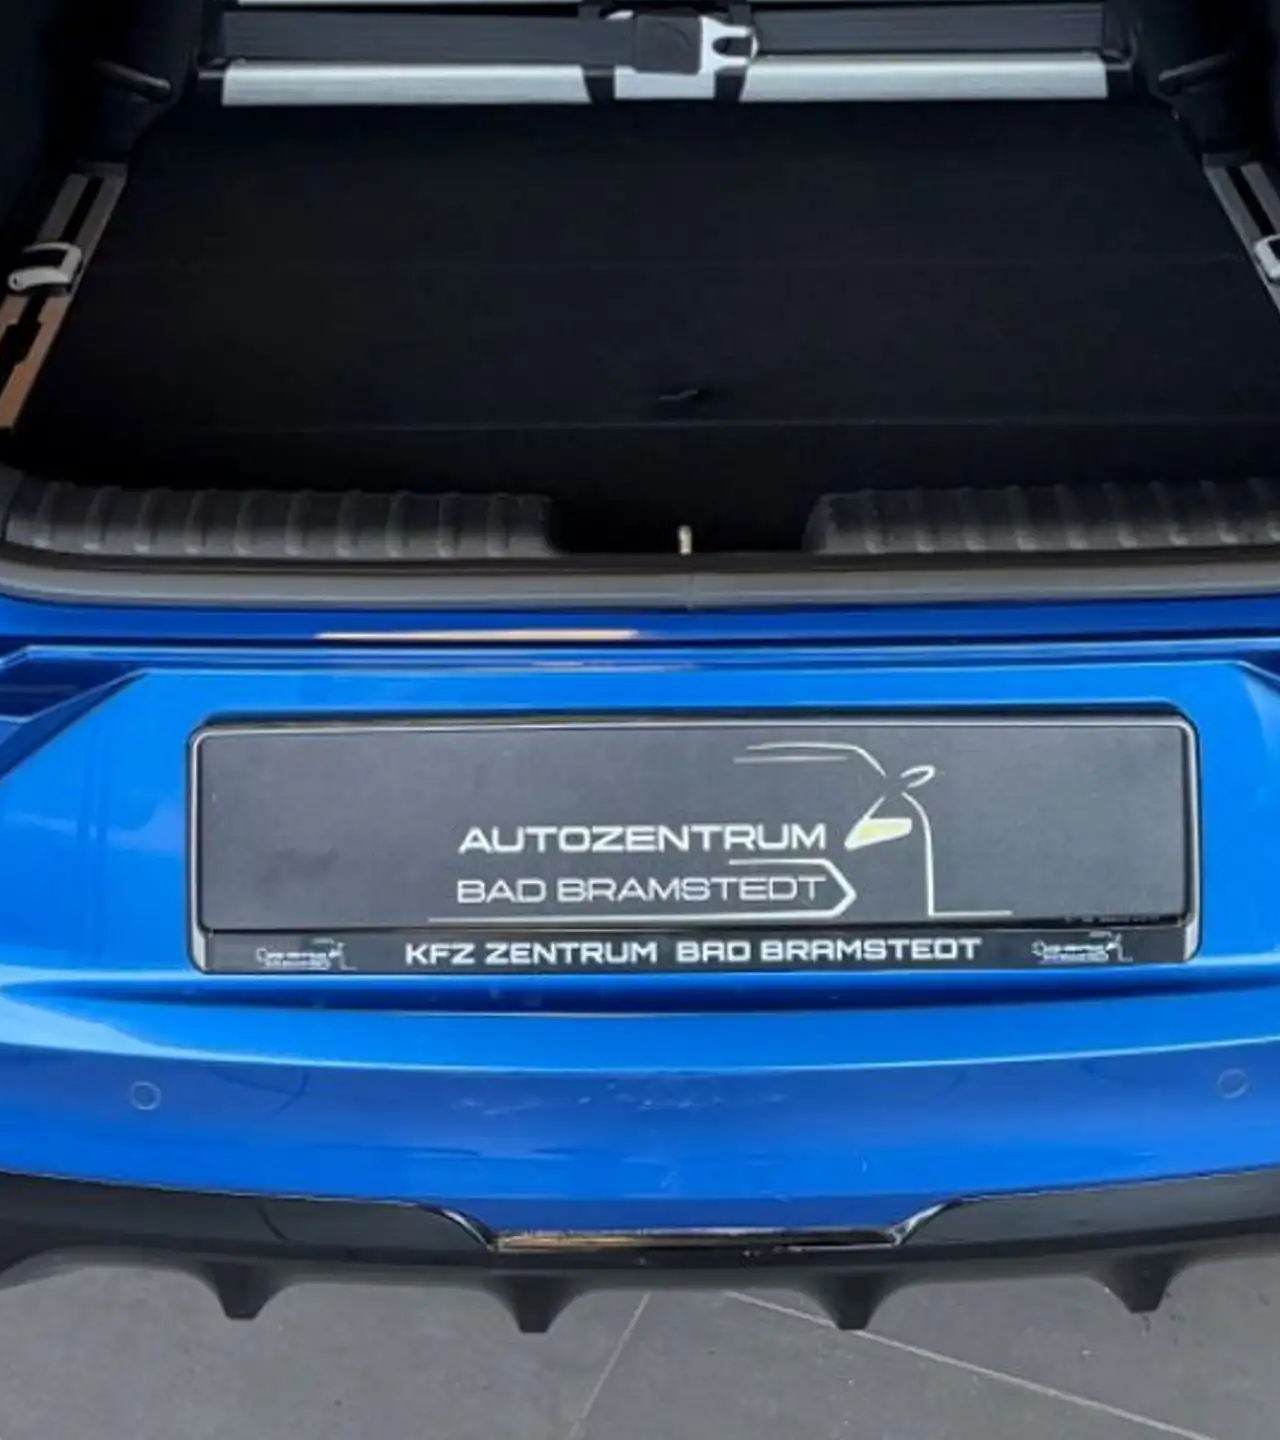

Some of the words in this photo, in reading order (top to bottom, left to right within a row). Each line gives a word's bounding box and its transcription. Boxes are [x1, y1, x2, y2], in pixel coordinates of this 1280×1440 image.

[457, 823, 827, 854] AUTOZENTRUM
[456, 878, 546, 904] BAD
[556, 875, 827, 903] BRAMSTEDT
[405, 943, 475, 965] KFZ
[485, 942, 658, 965] ZENTRUM
[676, 940, 748, 963] BAD
[760, 937, 981, 962] BRAMSTEDT
